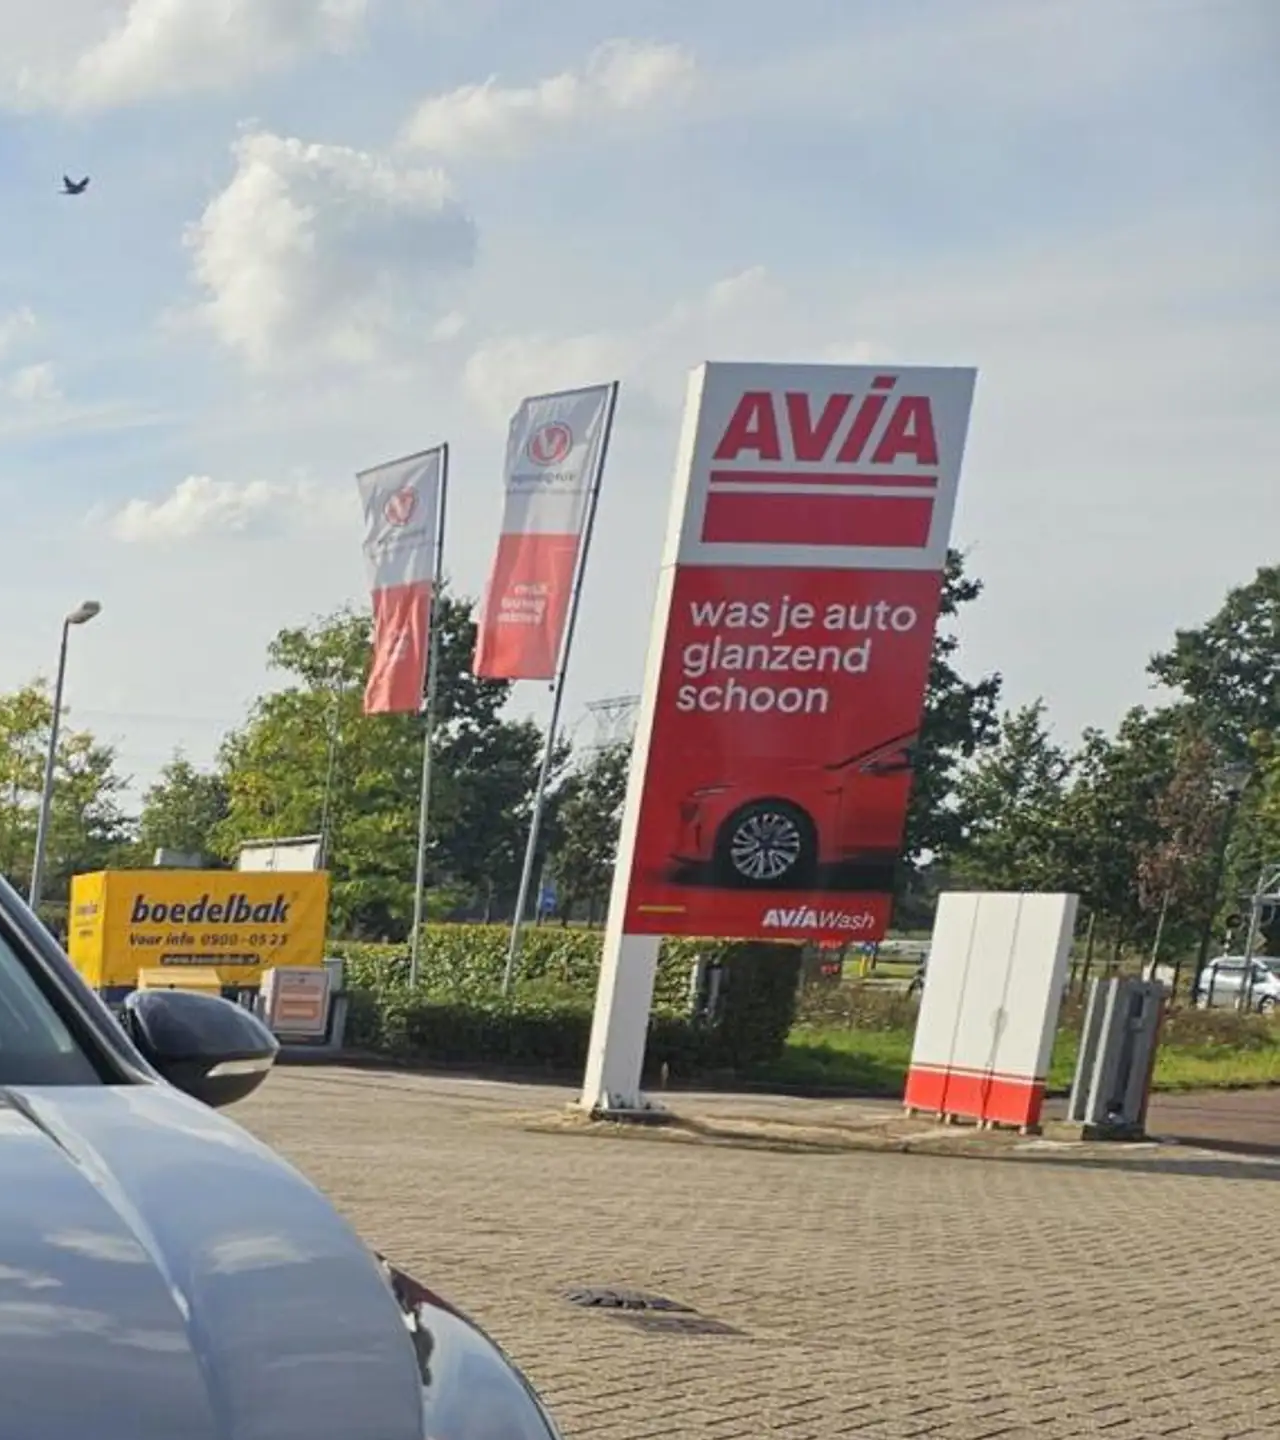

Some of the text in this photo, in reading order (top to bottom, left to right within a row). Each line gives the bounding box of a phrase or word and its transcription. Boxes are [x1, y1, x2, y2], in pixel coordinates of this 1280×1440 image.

[690, 595, 918, 637] was je auto
[682, 635, 872, 678] glanzend
[675, 677, 829, 713] schoon
[130, 892, 291, 924] boedelbak
